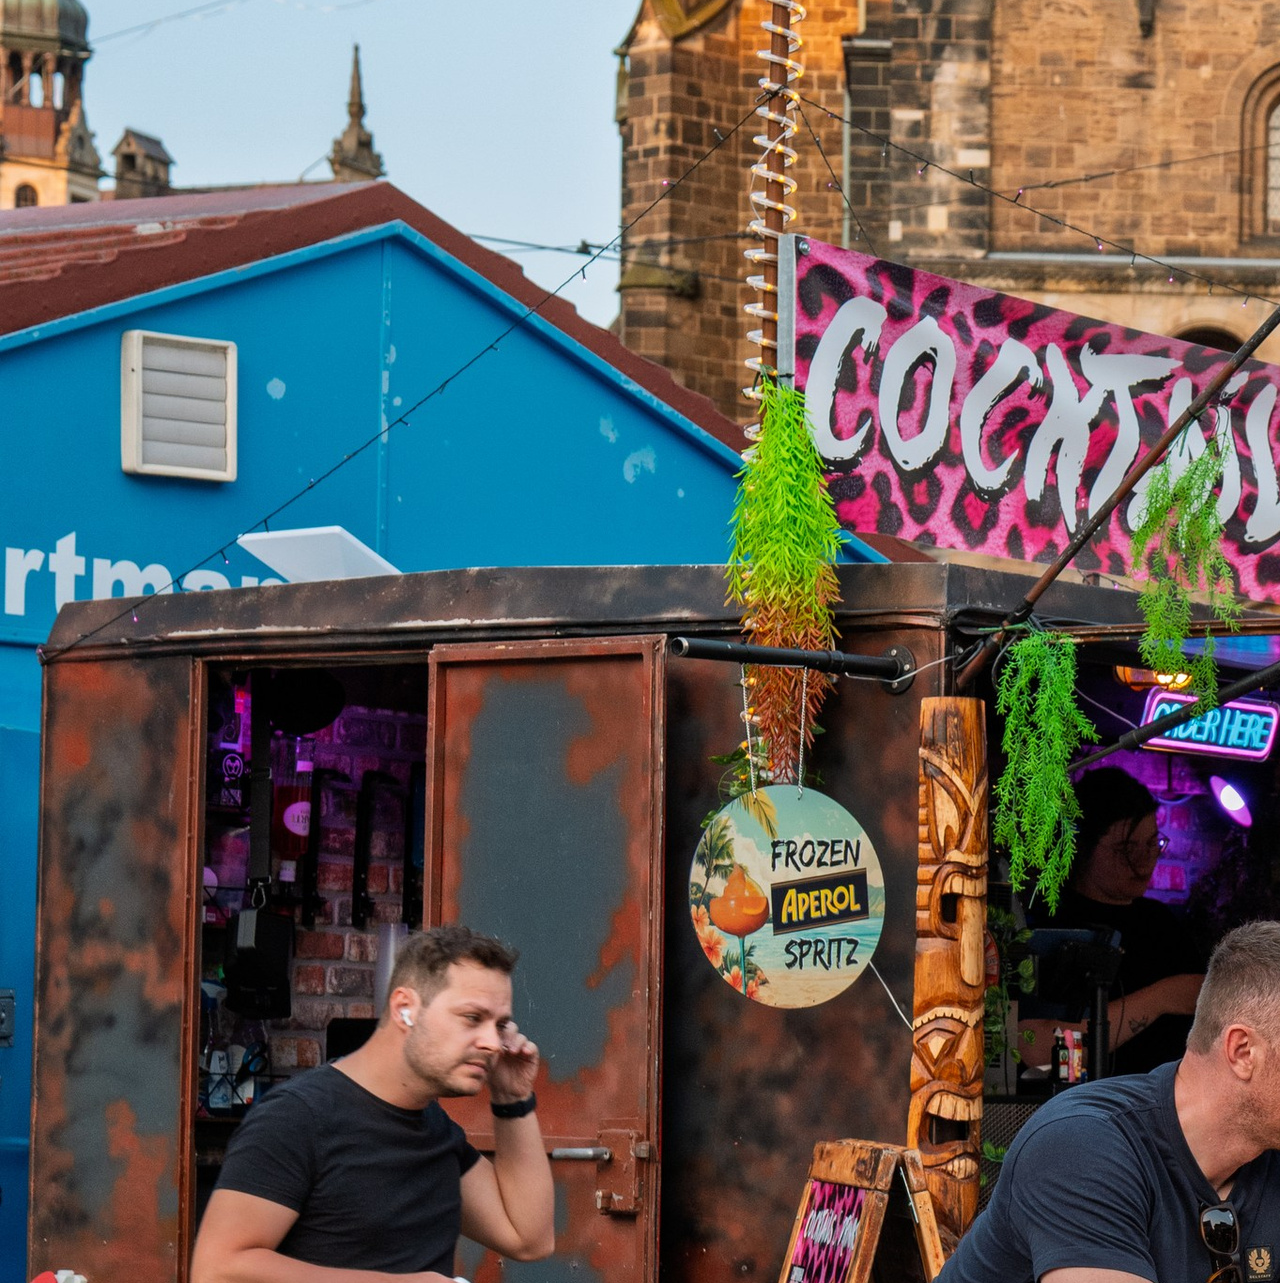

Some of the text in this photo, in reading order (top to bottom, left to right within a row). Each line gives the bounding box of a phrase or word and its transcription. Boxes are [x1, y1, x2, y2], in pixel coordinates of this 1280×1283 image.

[1218, 707, 1274, 749] HERE
[770, 839, 861, 872] FROZEN
[781, 884, 862, 923] APEROL
[784, 937, 861, 971] SPRITZ
